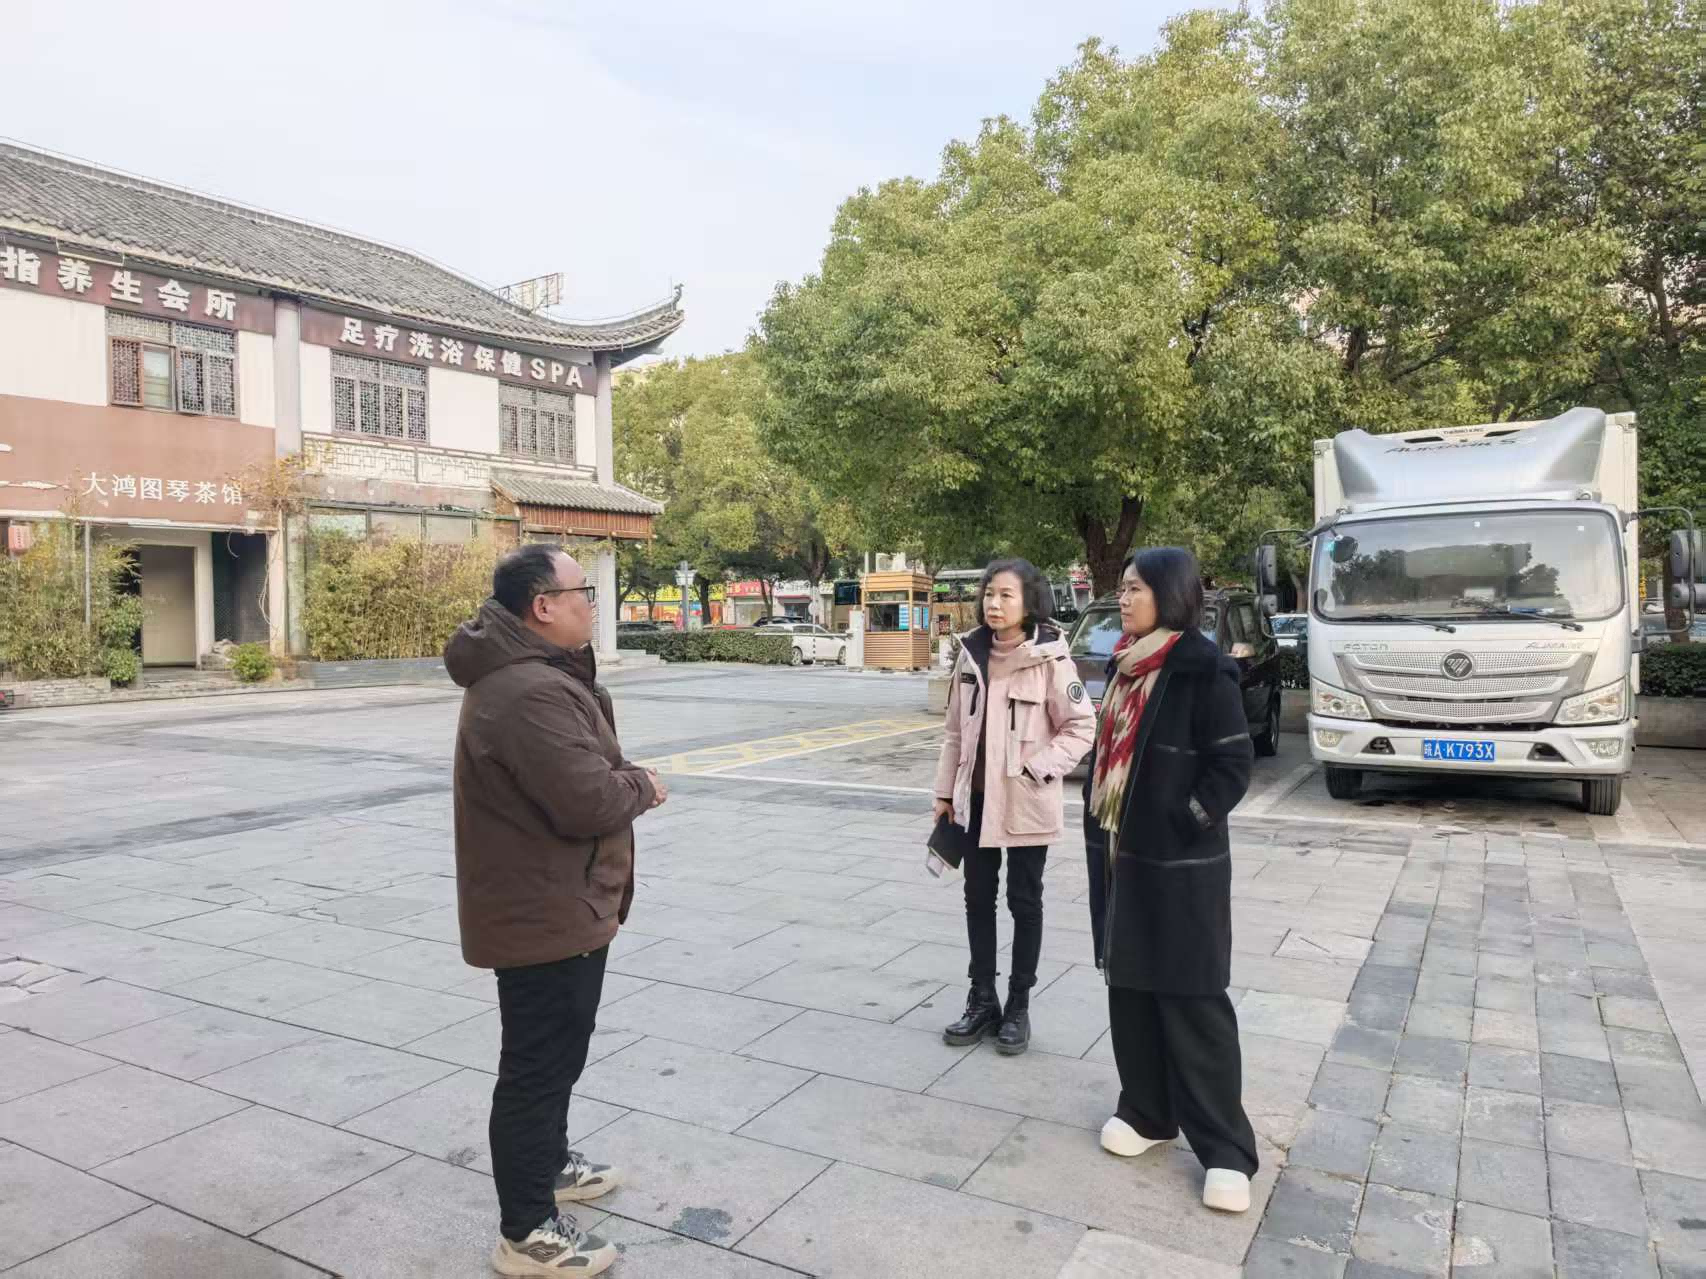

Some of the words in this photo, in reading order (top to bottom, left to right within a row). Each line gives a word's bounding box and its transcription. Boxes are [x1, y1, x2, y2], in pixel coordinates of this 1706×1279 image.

[0, 246, 237, 320] 指养生会所
[81, 471, 243, 505] 大鸿图琴茶馆
